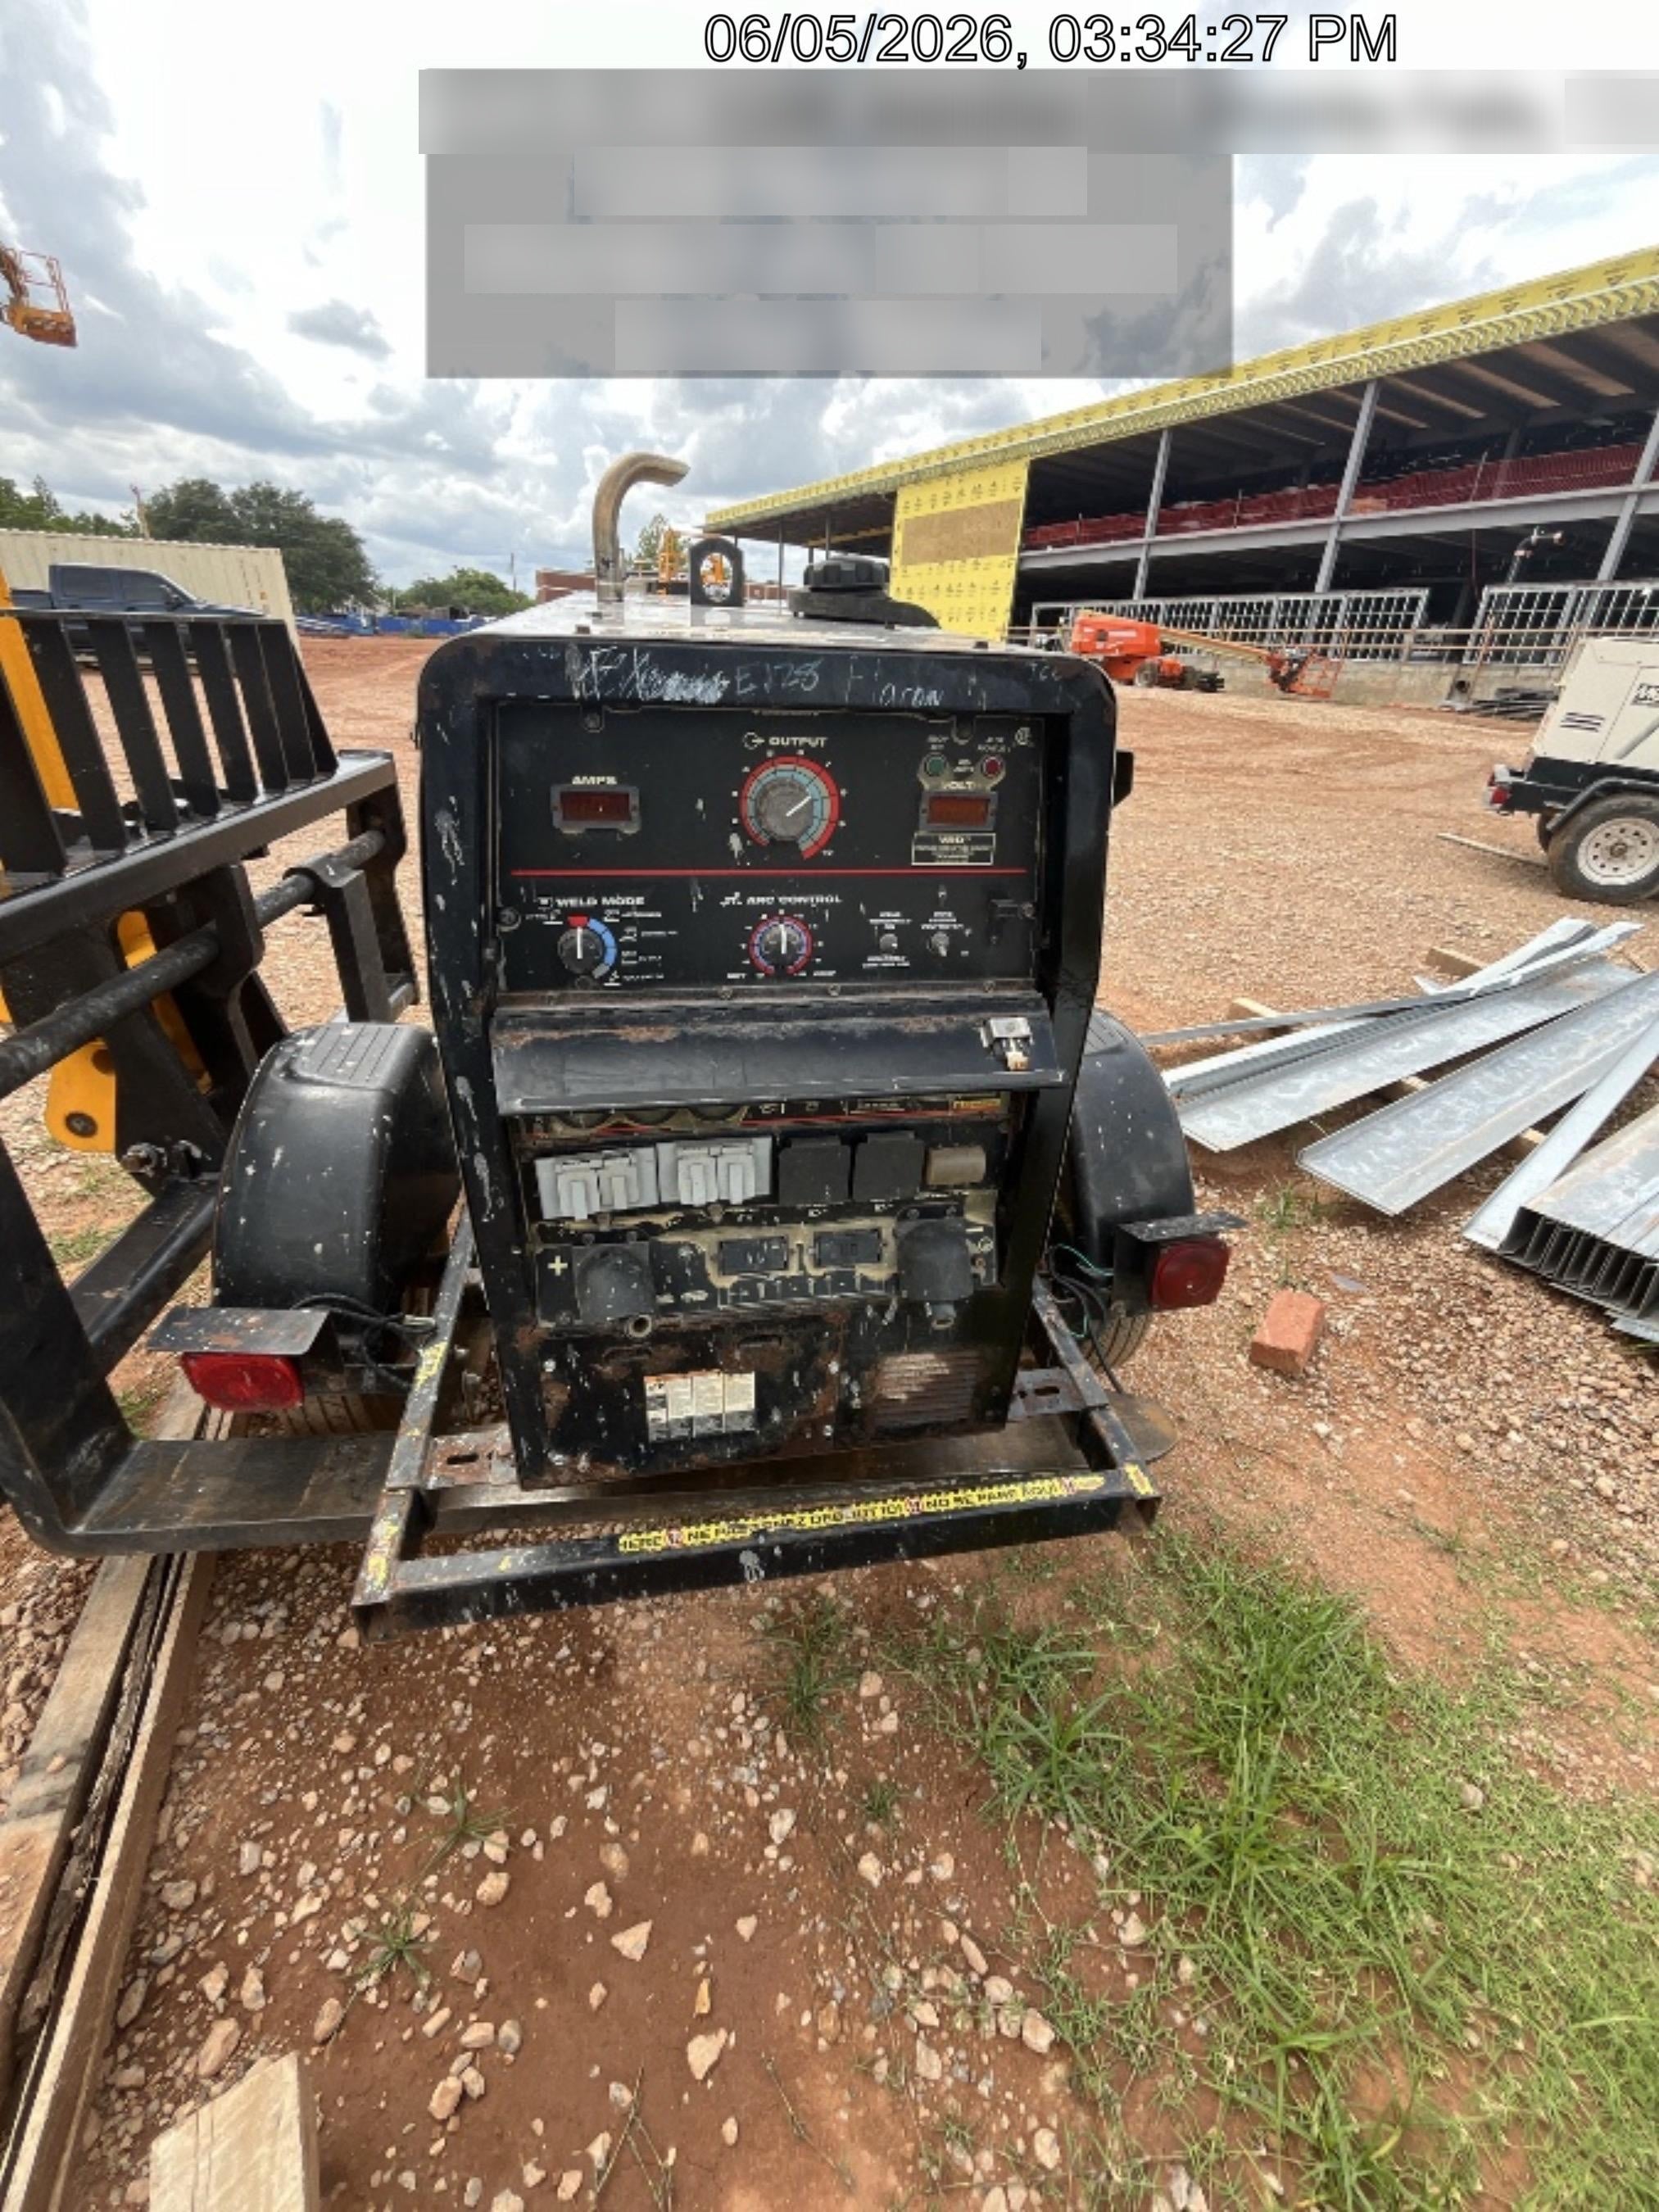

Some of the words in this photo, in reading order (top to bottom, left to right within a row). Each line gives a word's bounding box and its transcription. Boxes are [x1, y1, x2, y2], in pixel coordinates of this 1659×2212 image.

[768, 737, 827, 747] OUTPUT
[571, 775, 618, 785] AMPS
[556, 895, 598, 908] WELD
[601, 895, 646, 906] MODE
[746, 895, 775, 905] ARC
[778, 893, 843, 906] CONTROL
